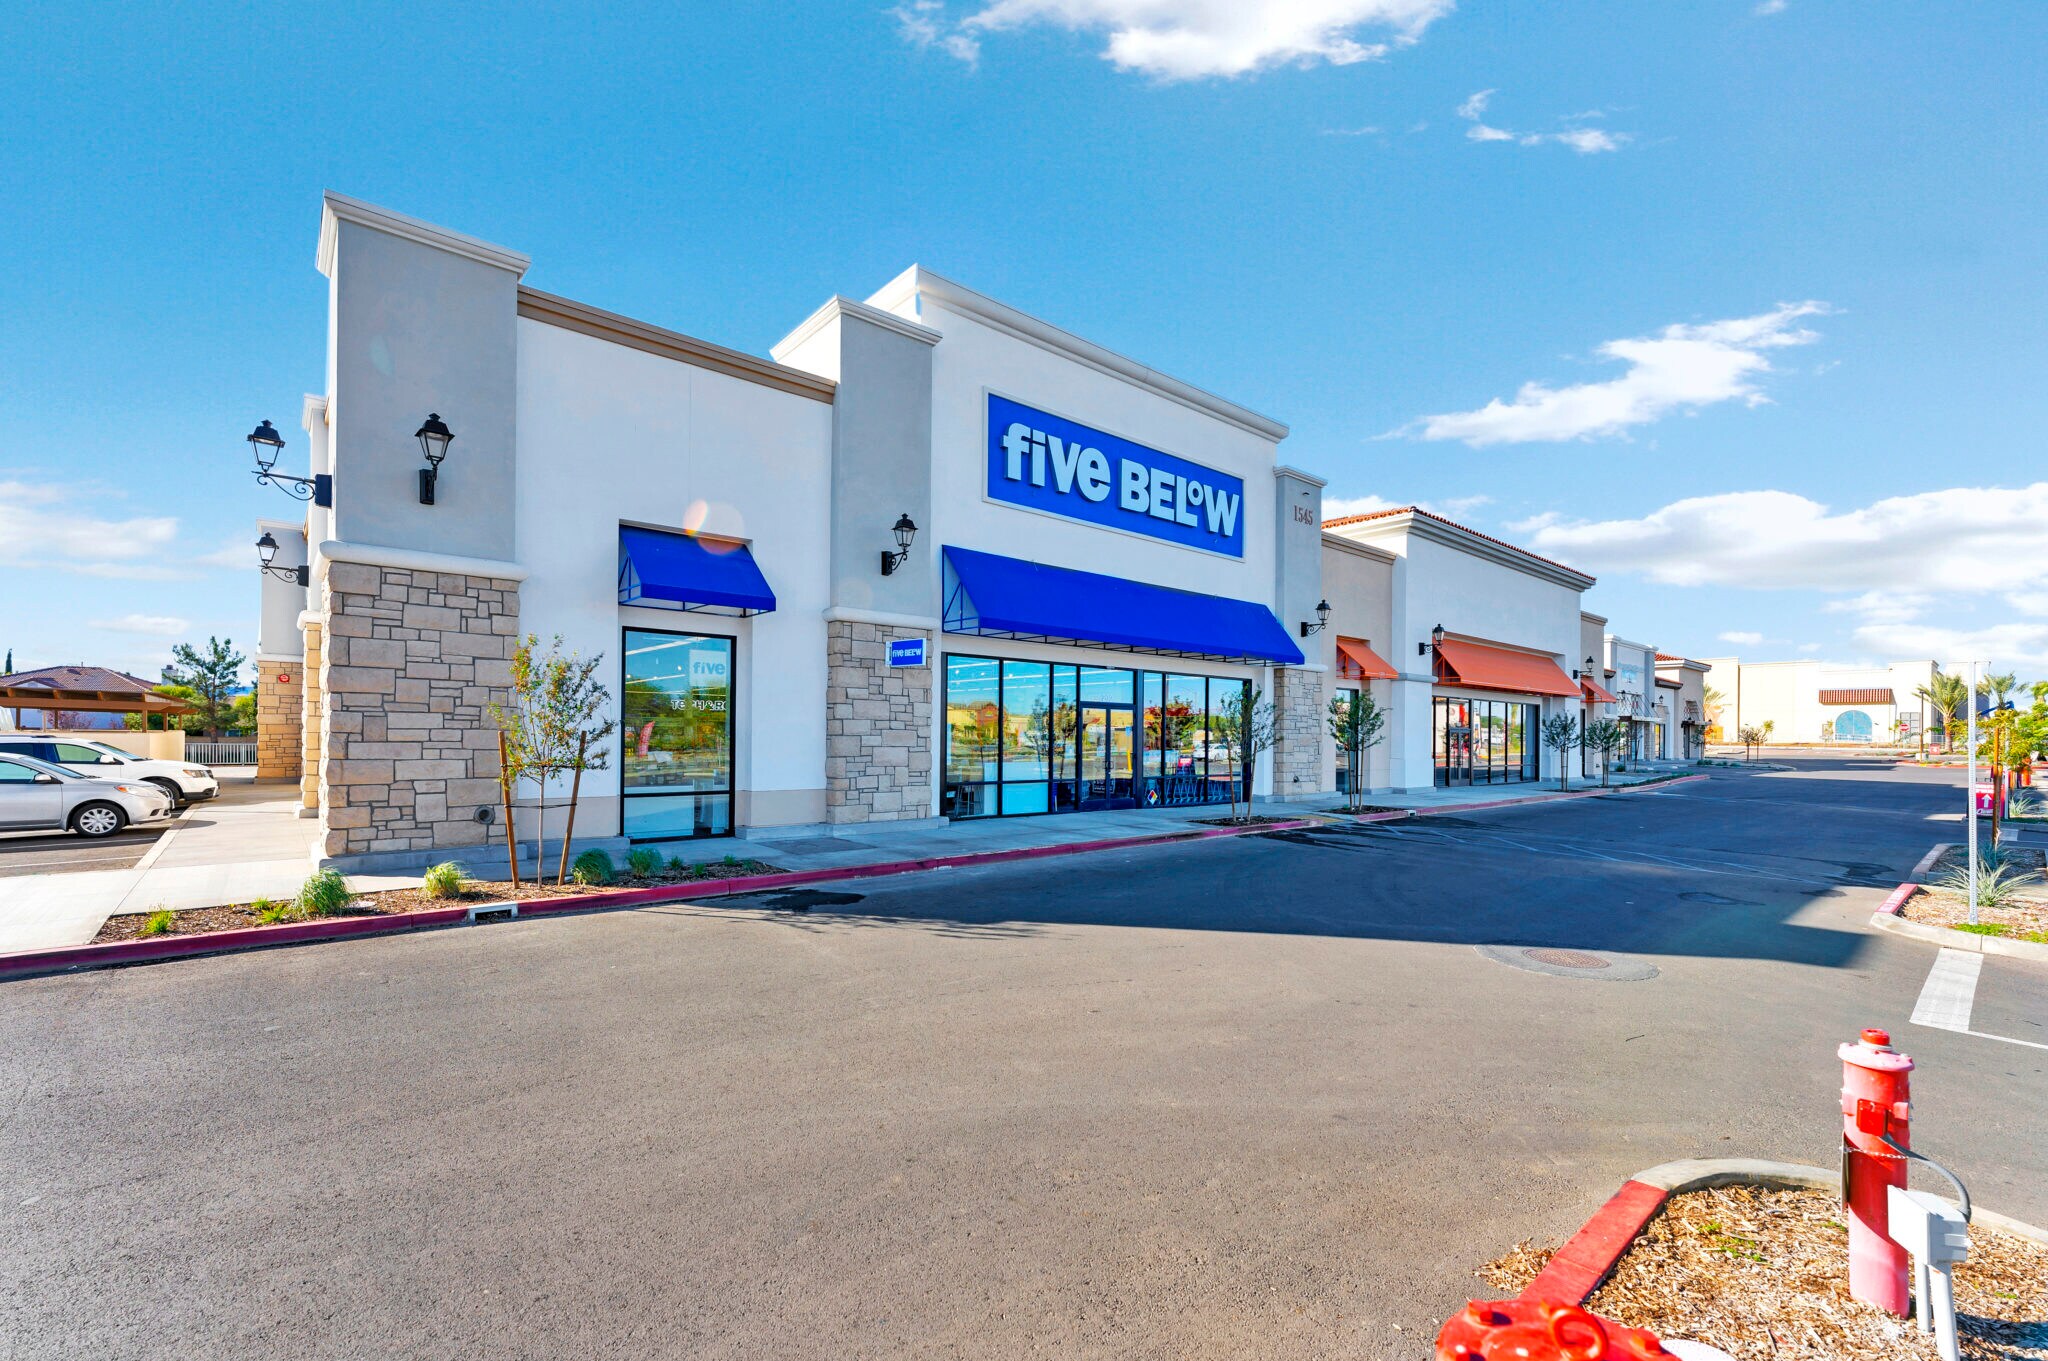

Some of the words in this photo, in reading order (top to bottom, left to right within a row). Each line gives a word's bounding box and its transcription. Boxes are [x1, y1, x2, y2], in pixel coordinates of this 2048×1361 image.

[1002, 422, 1111, 502] five
[1118, 458, 1240, 537] BELOW
[1294, 504, 1314, 526] 1545
[693, 661, 726, 675] five
